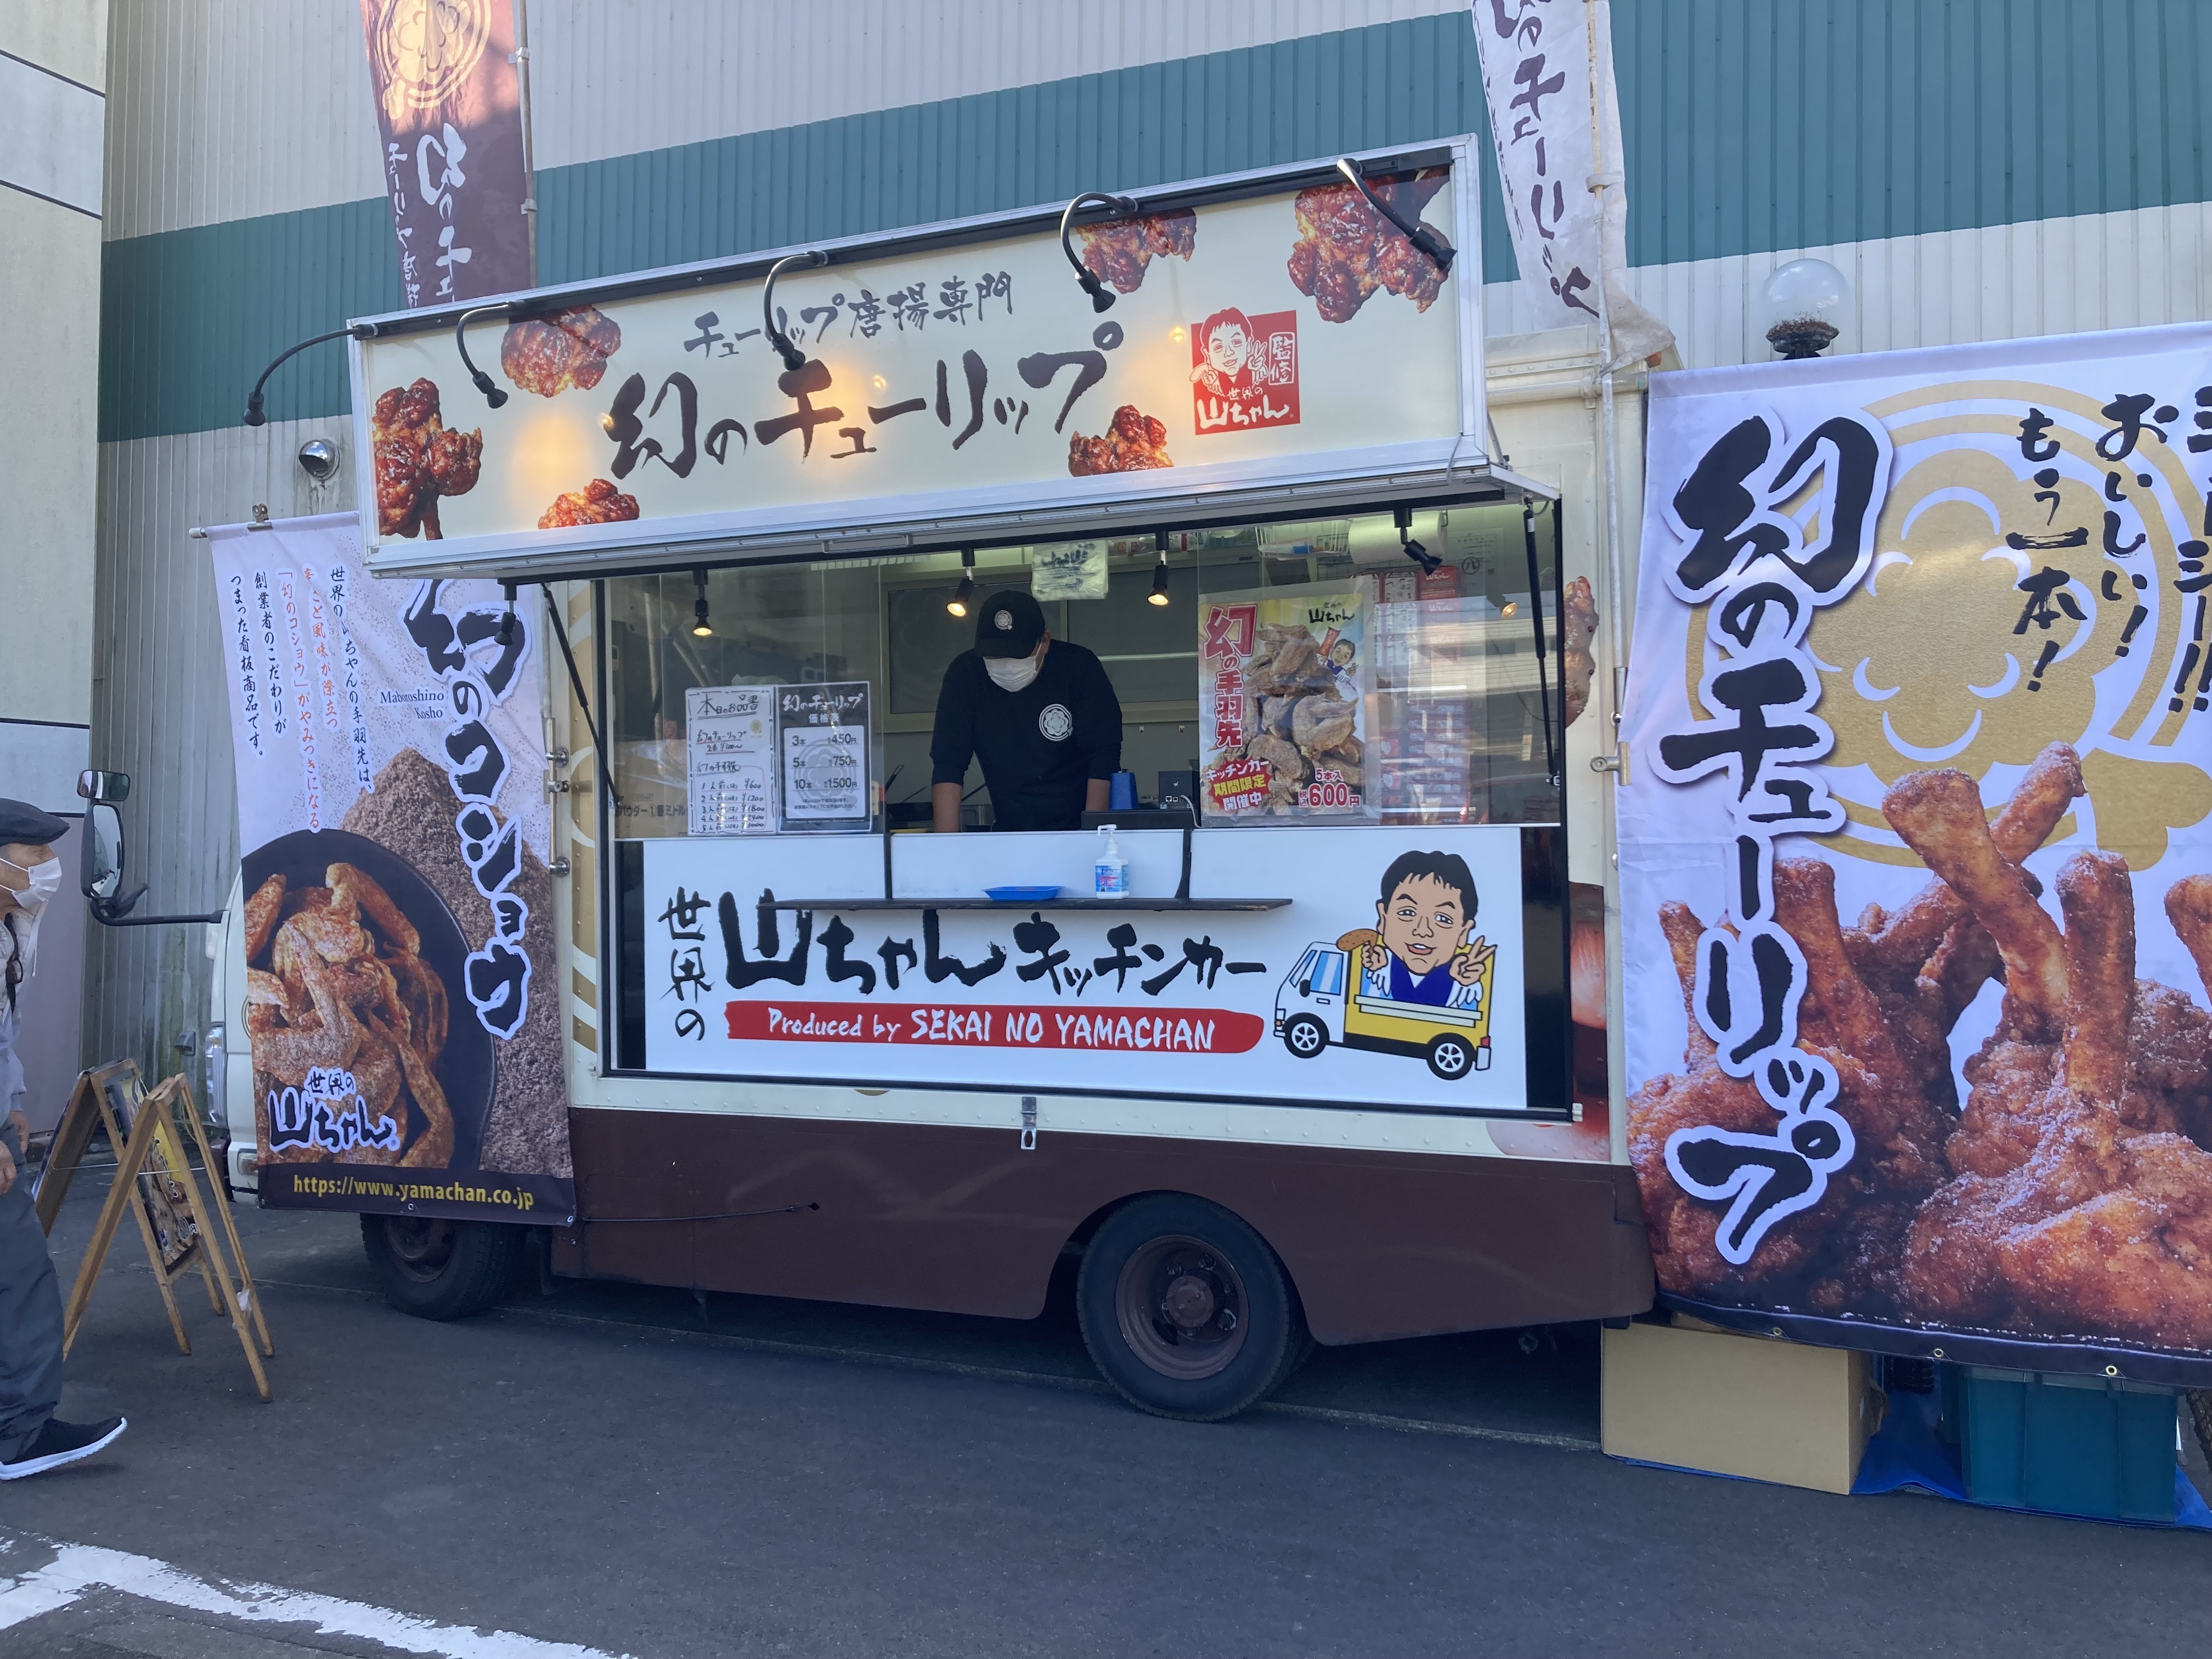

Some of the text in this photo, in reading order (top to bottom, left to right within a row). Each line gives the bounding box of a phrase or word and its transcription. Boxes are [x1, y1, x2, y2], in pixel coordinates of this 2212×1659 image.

[1269, 335, 1293, 382] 監修
[610, 320, 1124, 479] 幻のチューリップ
[1227, 386, 1263, 400] 世界の
[1196, 394, 1290, 430] 山ちゃん
[1308, 608, 1355, 624] 山ちゃん
[255, 571, 287, 734] 創業者のこだわりが
[230, 575, 263, 755] つまった看板商品です。
[1204, 605, 1257, 748] 幻の手羽先
[380, 689, 444, 704] Maboroshino
[782, 692, 864, 712] 幻のチューリップ
[414, 706, 443, 719] Kosho
[792, 735, 806, 746] 3本
[793, 757, 806, 768] 5本
[1205, 759, 1269, 781] キッチンカー
[794, 779, 812, 789] 10本
[1213, 774, 1267, 797] 期間限定
[1315, 768, 1344, 782] 5本入
[1222, 791, 1262, 811] 開催中
[1659, 416, 1879, 1253] 幻のチューリップ
[658, 885, 714, 1042] 世界の
[768, 1007, 1215, 1051] Produced by SEKAI NO YAMACHAN
[307, 1071, 355, 1096] 世界の
[270, 1094, 393, 1148] 山ちゃん
[293, 1174, 534, 1211] https://www.yamachan.co.jp
